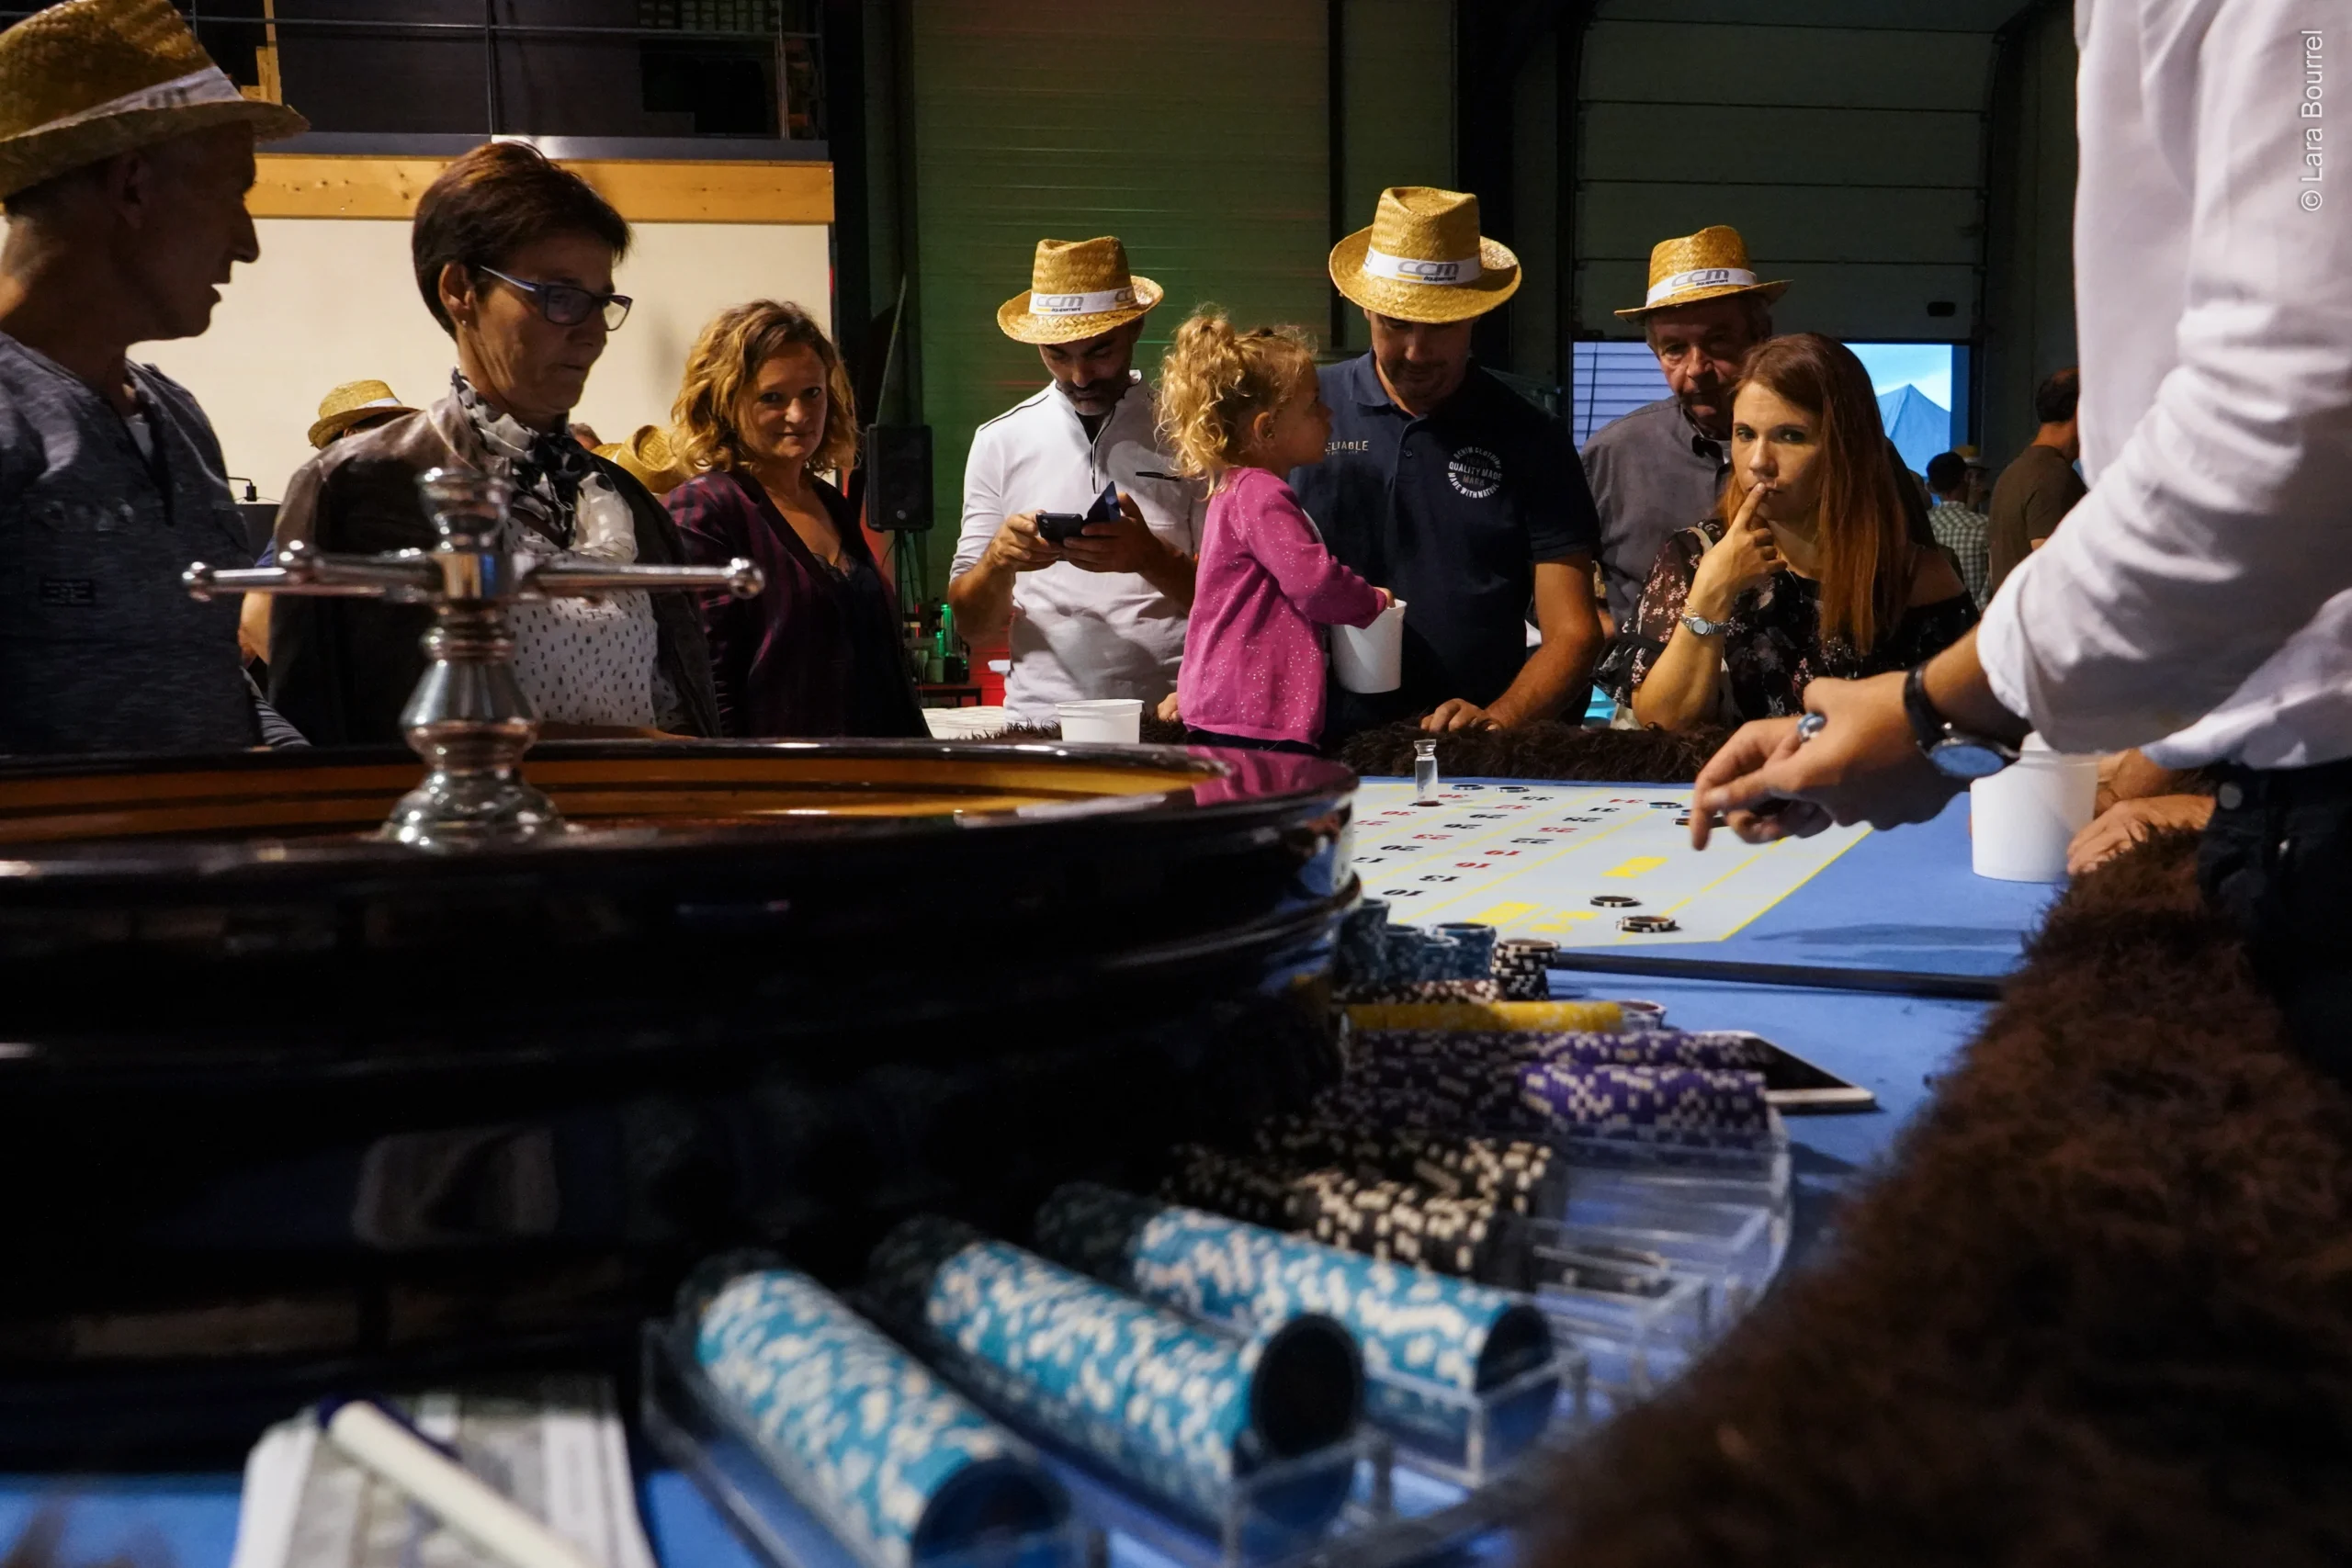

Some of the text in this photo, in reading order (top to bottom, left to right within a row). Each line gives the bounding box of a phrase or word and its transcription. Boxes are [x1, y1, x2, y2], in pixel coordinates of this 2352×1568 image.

[1449, 461, 1481, 477] QUALITY
[1447, 472, 1463, 491] MADE
[1460, 487, 1477, 499] WITH
